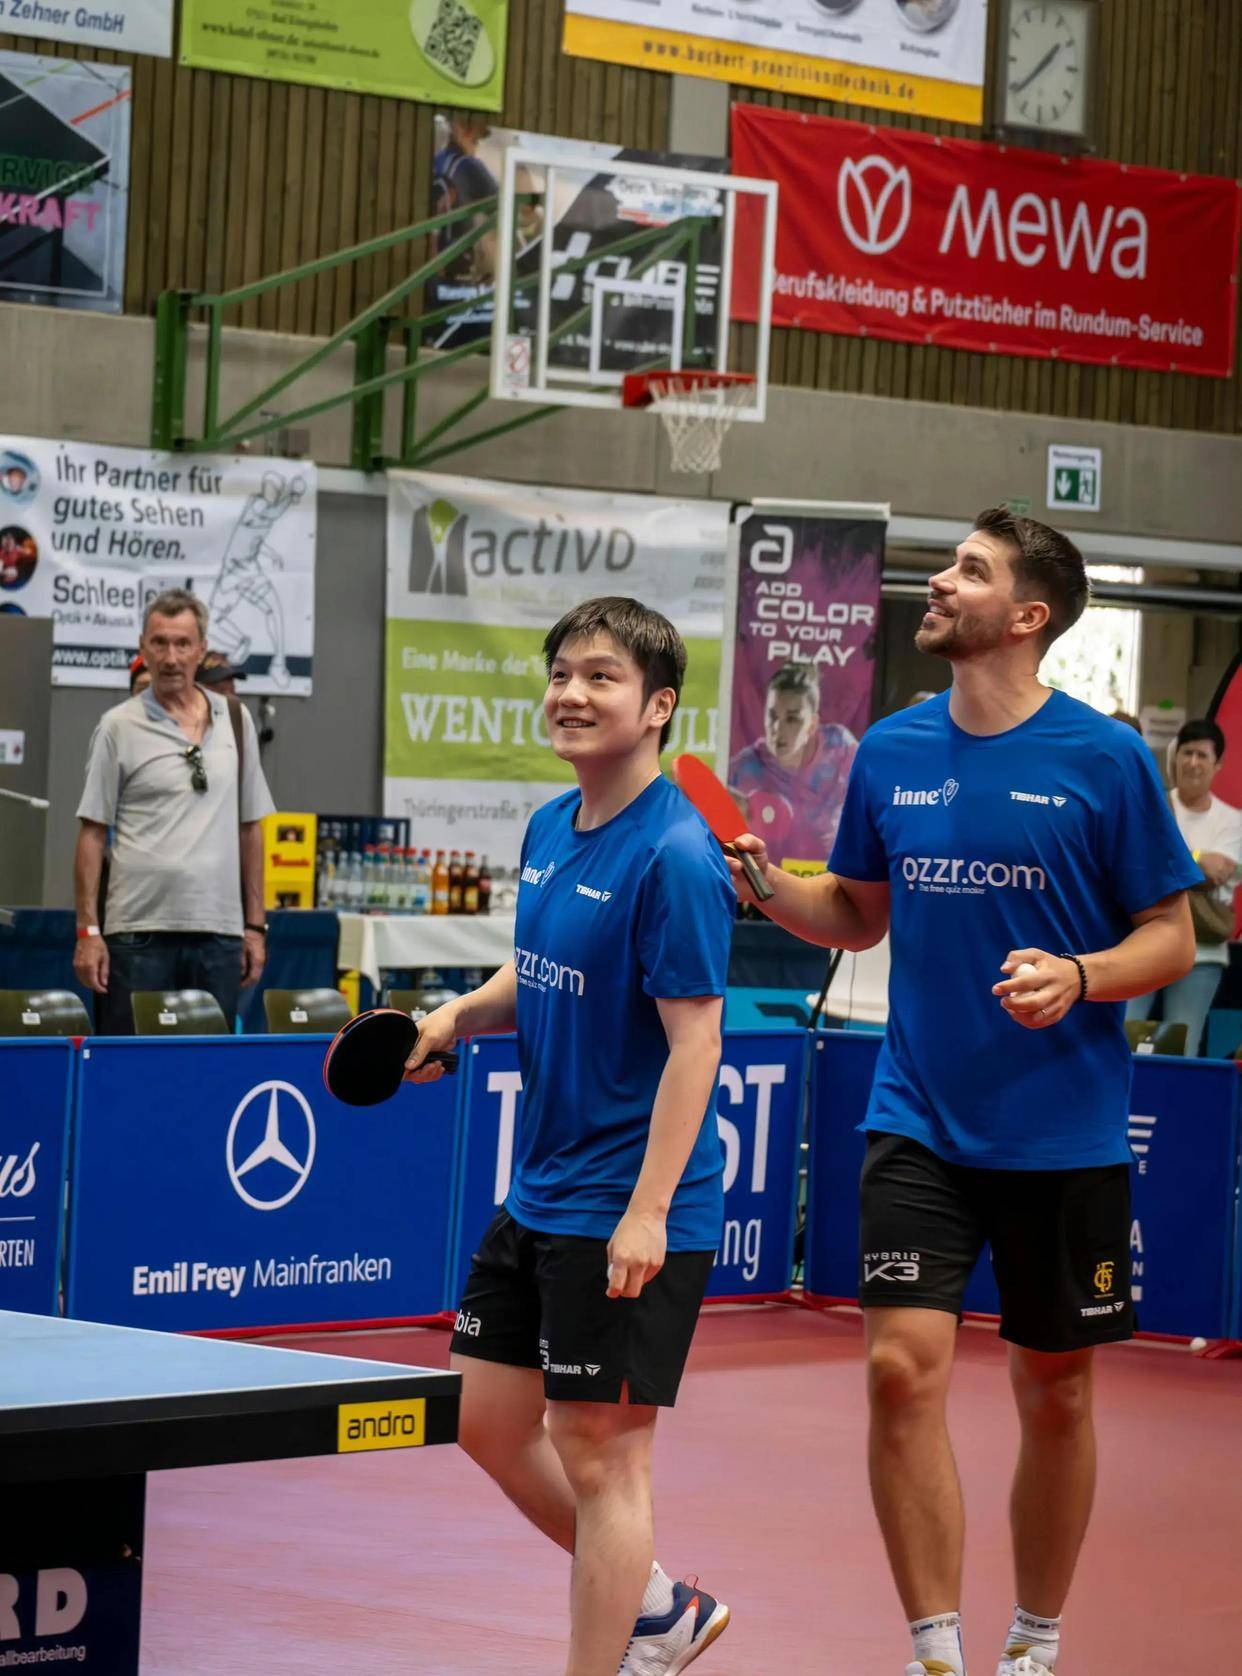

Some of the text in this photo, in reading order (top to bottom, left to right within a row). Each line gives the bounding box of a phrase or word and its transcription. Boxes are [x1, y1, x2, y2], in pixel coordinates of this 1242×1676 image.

[10, 0, 70, 24] Zehner
[75, 8, 125, 34] GmbH
[774, 271, 1203, 347] erufskleidung & Putztücher im Rundum-Service
[56, 454, 224, 494] Ihr Partner für
[53, 495, 204, 528] gutes Sehen
[51, 526, 186, 560] und Hören.
[470, 513, 636, 578] activo
[755, 581, 803, 597] ADD
[756, 598, 875, 627] COLOR
[749, 622, 843, 642] TO YOUR
[402, 646, 437, 671] Eine
[442, 649, 496, 674] Marke
[767, 640, 857, 668] PLAY
[1009, 791, 1051, 805] TIBHAR
[902, 856, 1046, 890] ozzr.com
[576, 883, 602, 900] TIBHAR
[514, 946, 584, 996] zzr.com
[864, 1251, 920, 1262] HYBRID
[133, 1252, 391, 1298] Emil Frey Mainfranken
[864, 1261, 920, 1283] K3
[1080, 1305, 1113, 1317] TIBHAR
[550, 1364, 582, 1375] TIBHAR
[347, 1411, 415, 1440] andro
